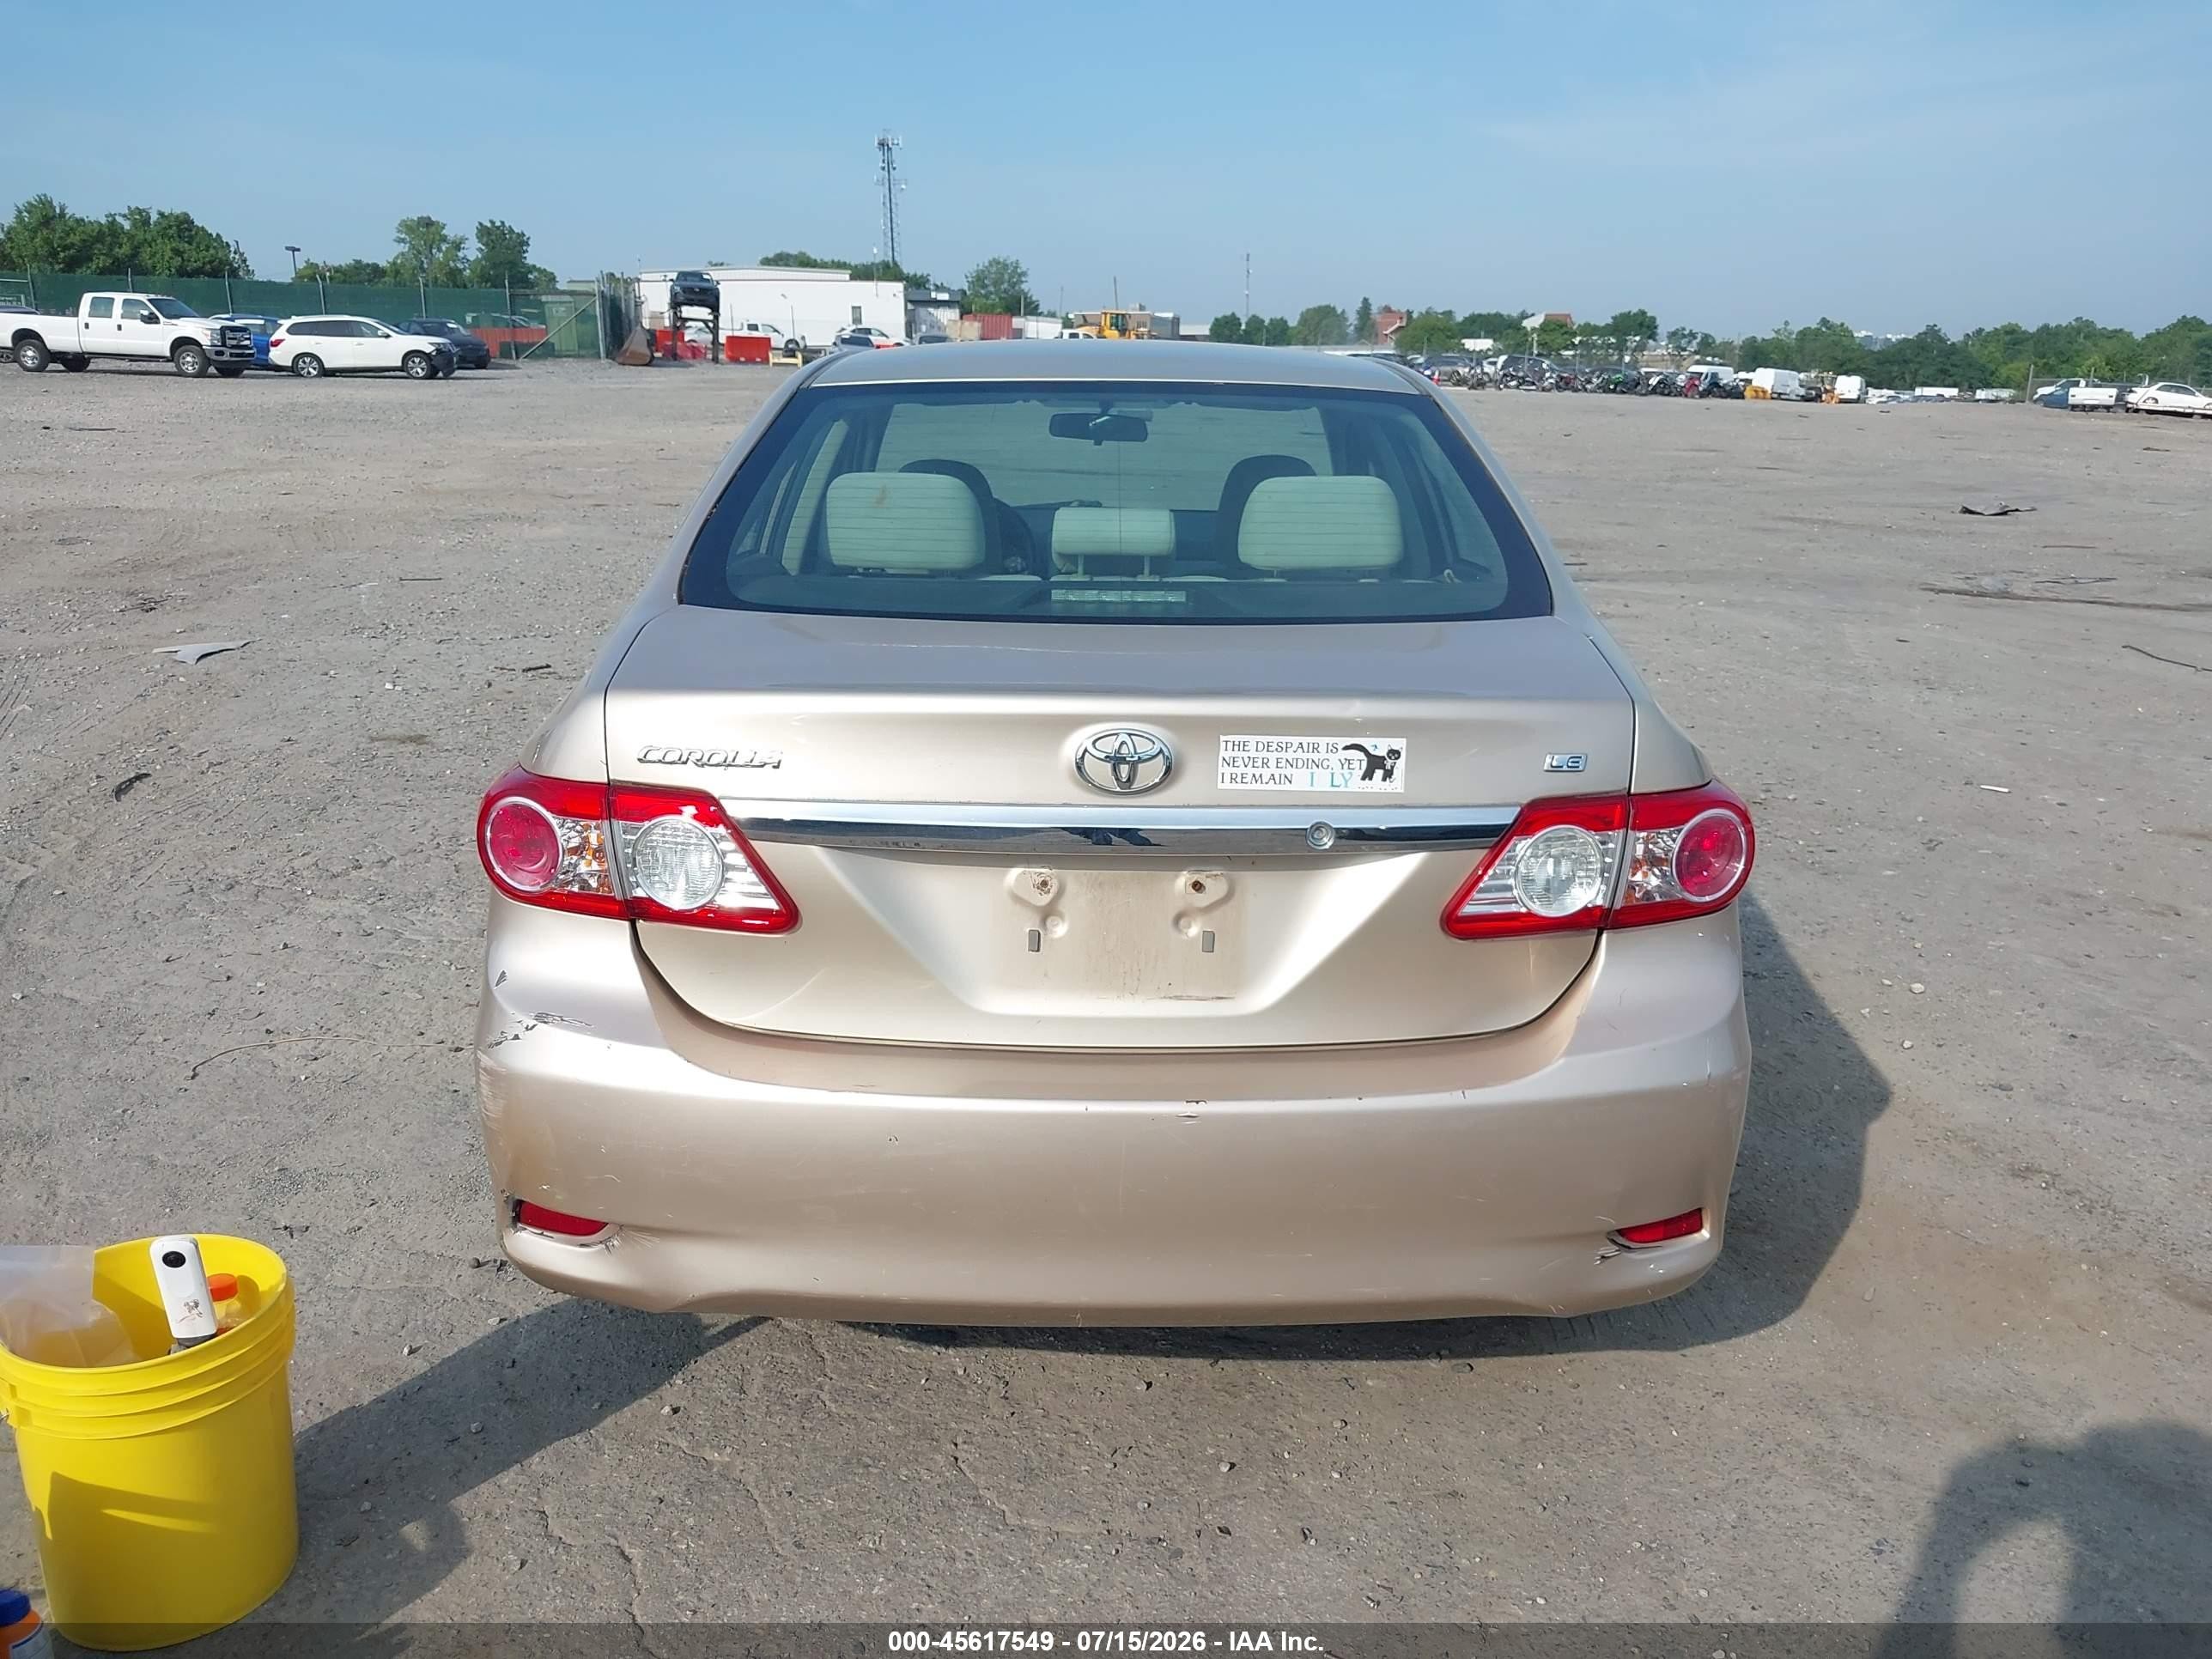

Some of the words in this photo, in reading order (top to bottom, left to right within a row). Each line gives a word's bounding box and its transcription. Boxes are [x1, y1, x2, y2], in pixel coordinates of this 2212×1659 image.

[1222, 739, 1250, 752] THE
[1255, 741, 1320, 754] DESPAIR
[1326, 742, 1340, 754] IS
[1221, 756, 1271, 769] NEVER
[1274, 757, 1334, 771] ENDING,
[1338, 758, 1365, 770] YET
[1548, 754, 1583, 769] LE
[1220, 772, 1225, 784] I
[1230, 773, 1294, 785] REMAIN
